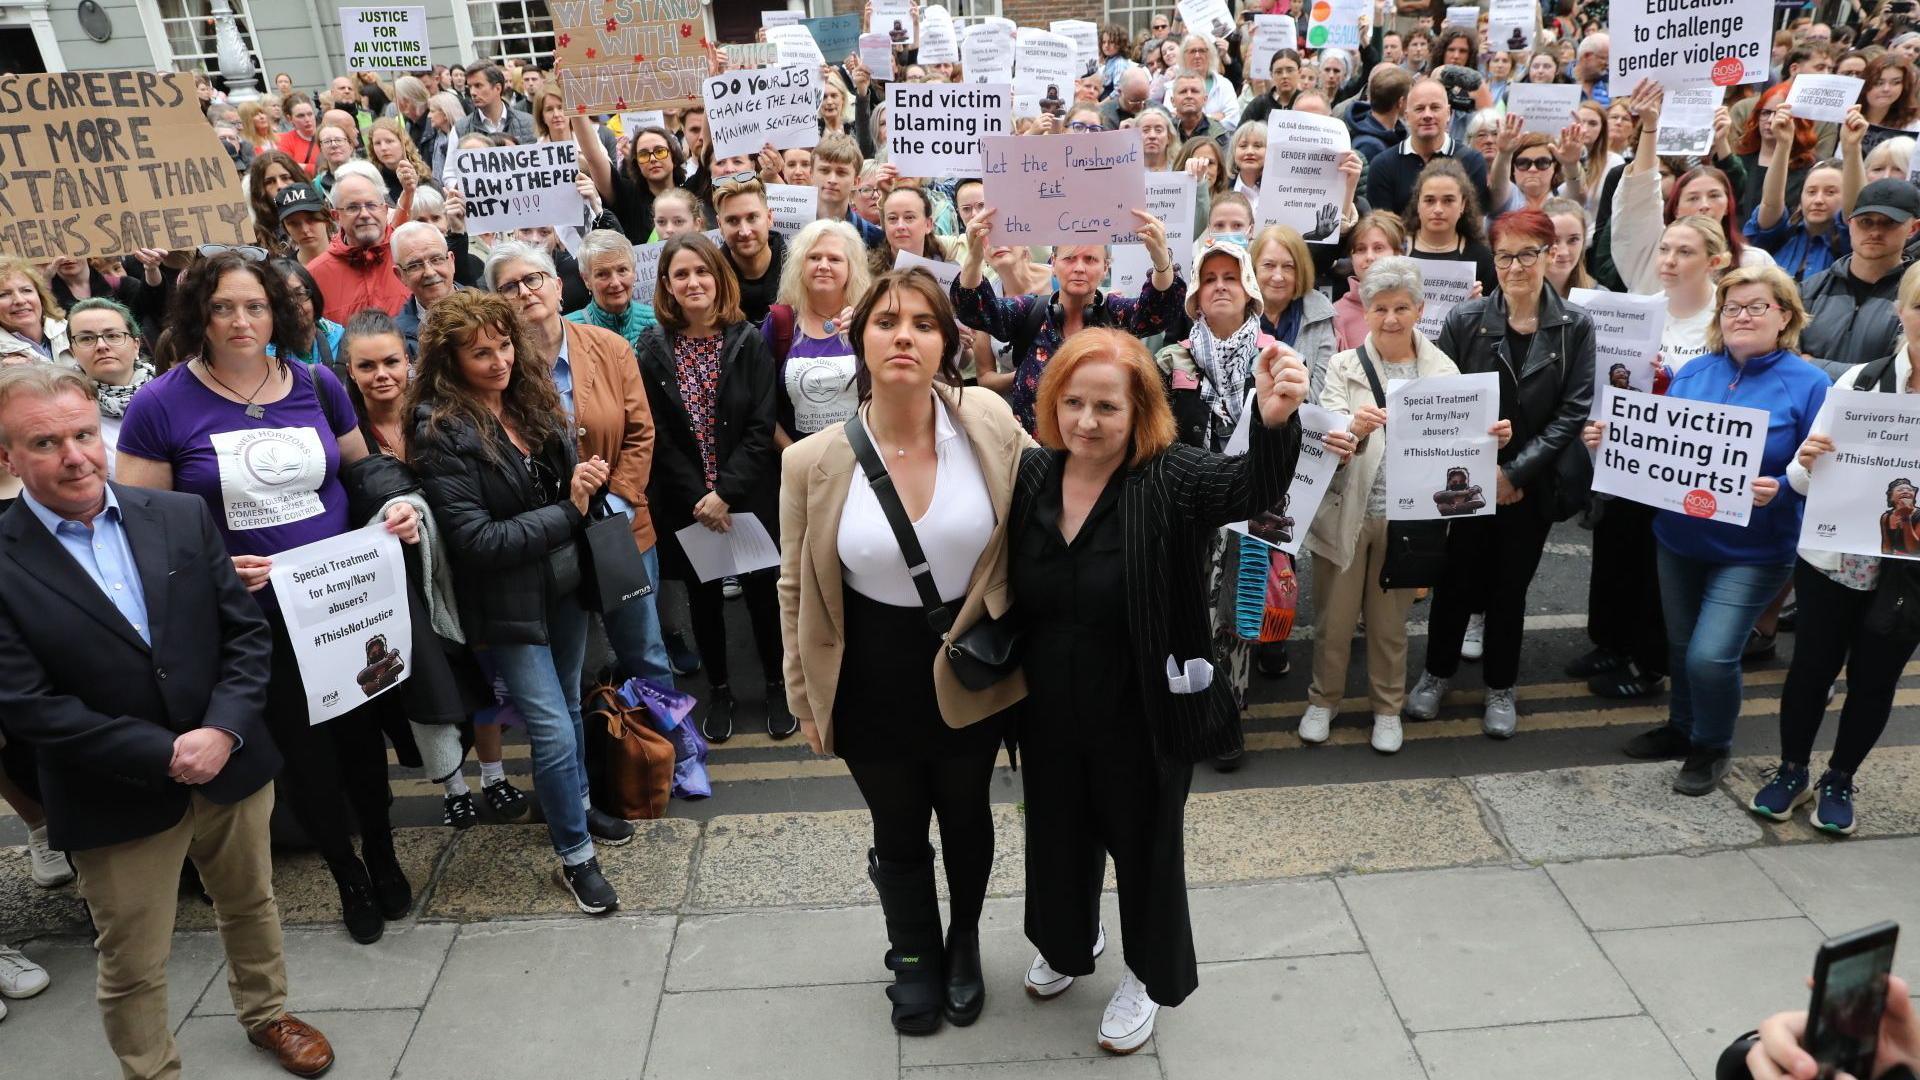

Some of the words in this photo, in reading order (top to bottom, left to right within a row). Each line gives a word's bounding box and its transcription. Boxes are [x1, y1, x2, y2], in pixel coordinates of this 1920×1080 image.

[359, 11, 408, 23] JUSTICE
[552, 0, 606, 28] WE
[613, 0, 702, 25] STAND
[373, 26, 397, 37] FOR
[1634, 24, 1649, 43] to
[1656, 16, 1743, 40] challenge
[371, 41, 420, 52] VICTIMS
[595, 23, 679, 57] WITH
[350, 56, 364, 68] OF
[369, 55, 427, 67] VIOLENCE
[1619, 48, 1678, 77] gender
[1683, 42, 1760, 65] violence
[27, 71, 184, 111] CAREERS
[560, 56, 710, 110] NATASHA
[711, 78, 741, 99] DO
[748, 75, 780, 95] YOUR
[780, 65, 810, 88] JOB
[767, 93, 786, 110] THE
[896, 90, 933, 108] End
[940, 89, 1001, 108] victim
[894, 113, 977, 136] blaming
[984, 113, 1001, 131] in
[44, 116, 155, 163] MORE
[893, 136, 925, 154] the
[458, 150, 541, 173] CHANGE
[542, 145, 576, 165] THE
[1021, 153, 1048, 173] the
[1065, 144, 1137, 168] Punishment
[1281, 151, 1306, 160] GENDER
[1308, 152, 1336, 162] VIOLENCE
[139, 156, 227, 199] THAN
[1291, 166, 1321, 175] PANDEMIC
[462, 176, 502, 198] LAW
[1150, 187, 1182, 195] Treatment
[1293, 187, 1326, 195] emergency
[786, 195, 808, 203] violence
[1146, 201, 1176, 209] rmy/Navy
[1284, 200, 1302, 208] action
[94, 201, 249, 255] SAFETY
[1004, 216, 1031, 232] the
[1440, 294, 1465, 303] RACISM
[1616, 310, 1645, 320] harmed
[1604, 323, 1624, 334] Court
[1404, 396, 1434, 407] Special
[1436, 393, 1478, 404] Treatment
[1411, 412, 1424, 421] for
[1425, 410, 1470, 422] Army/Navy
[1612, 395, 1658, 423] End
[1667, 407, 1752, 439] victim
[1845, 411, 1895, 422] Survivors
[1422, 427, 1459, 436] abusers?
[1867, 429, 1877, 439] in
[1880, 429, 1909, 442] Court
[233, 433, 256, 456] HAVEN
[259, 430, 311, 455] HORIZONS
[1404, 447, 1480, 457] #ThisIsNotJustice
[1609, 422, 1713, 466] blaming
[1722, 443, 1748, 467] in
[1605, 448, 1640, 475] the
[1648, 463, 1746, 496] courts!
[232, 501, 257, 509] ZERO
[260, 491, 302, 507] TOLERANCE
[1685, 494, 1715, 510] ROSA
[229, 507, 279, 519] DOMESTIC
[233, 515, 282, 528] COERCIVE
[284, 505, 320, 521] CONTROL
[292, 563, 330, 584] Special
[330, 548, 379, 571] Treatment
[309, 587, 325, 600] for
[326, 571, 376, 597] Army/Navy
[328, 592, 368, 615] abusers?
[314, 608, 394, 647] #ThisIsNotJustice
